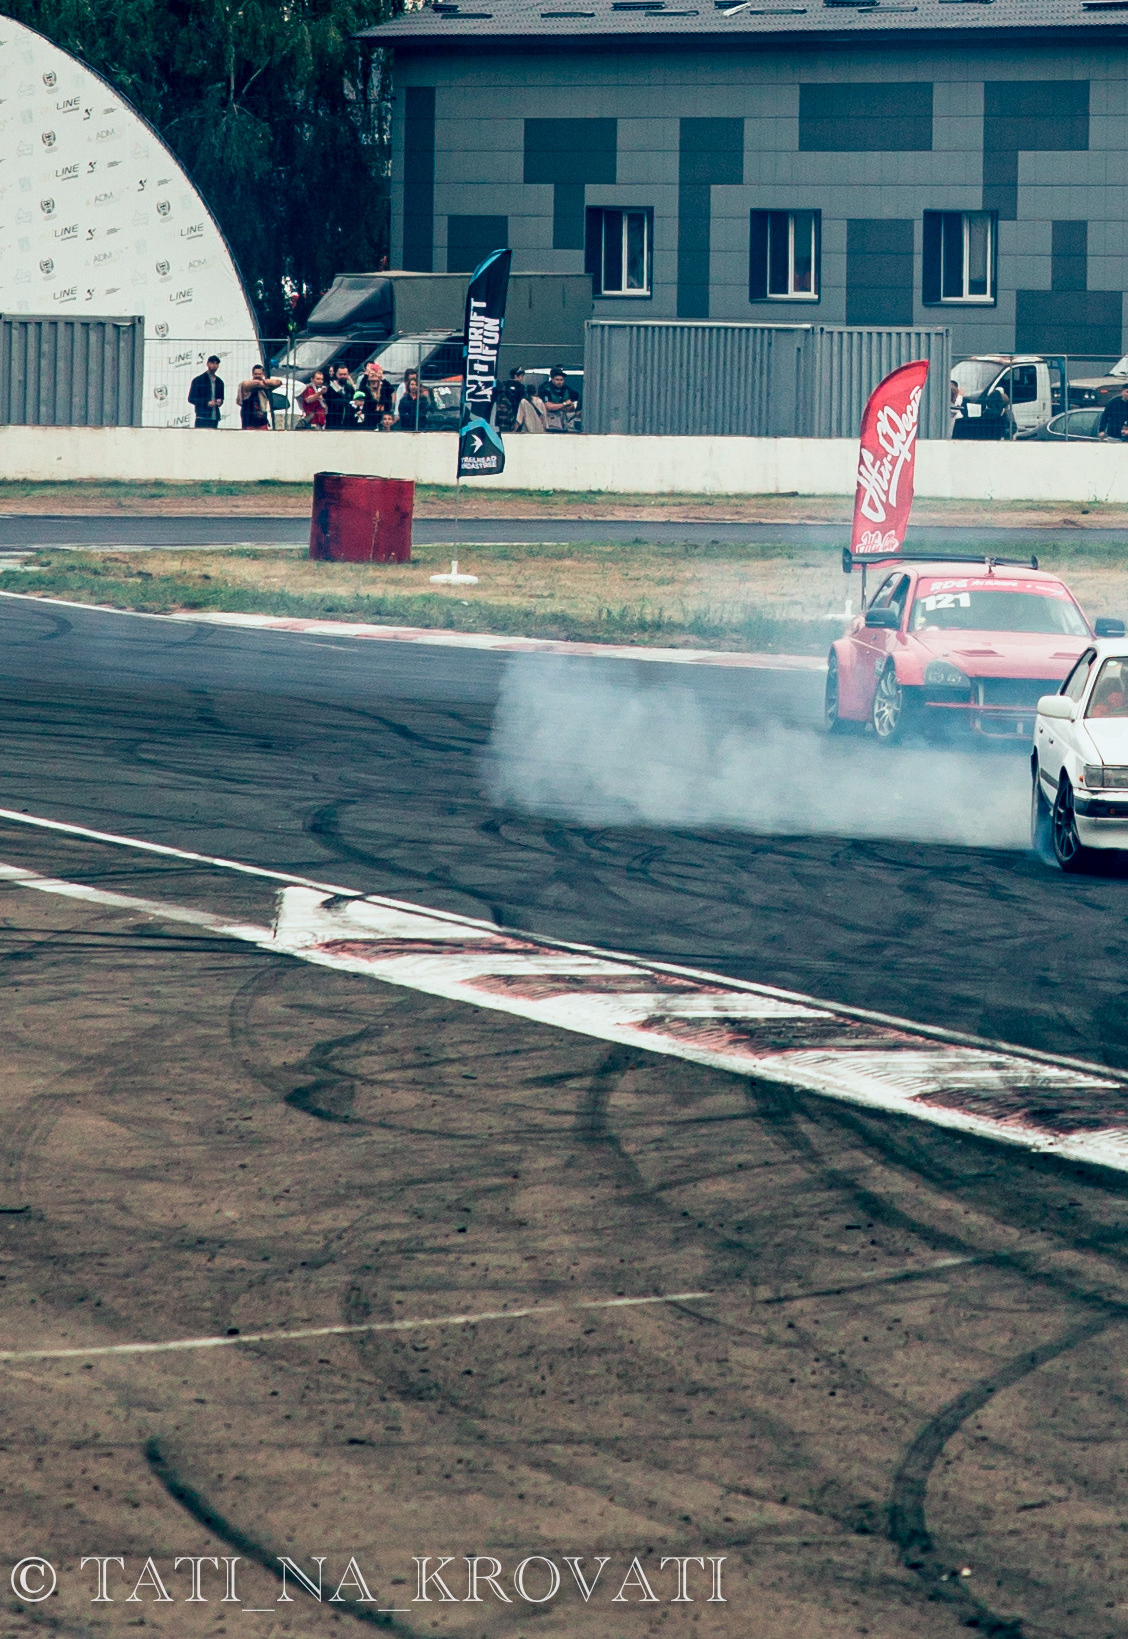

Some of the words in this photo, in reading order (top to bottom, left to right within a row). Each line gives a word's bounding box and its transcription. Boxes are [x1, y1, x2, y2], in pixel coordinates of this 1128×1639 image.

[467, 297, 487, 354] DRIFT
[482, 317, 500, 355] FUN
[921, 592, 971, 612] 121
